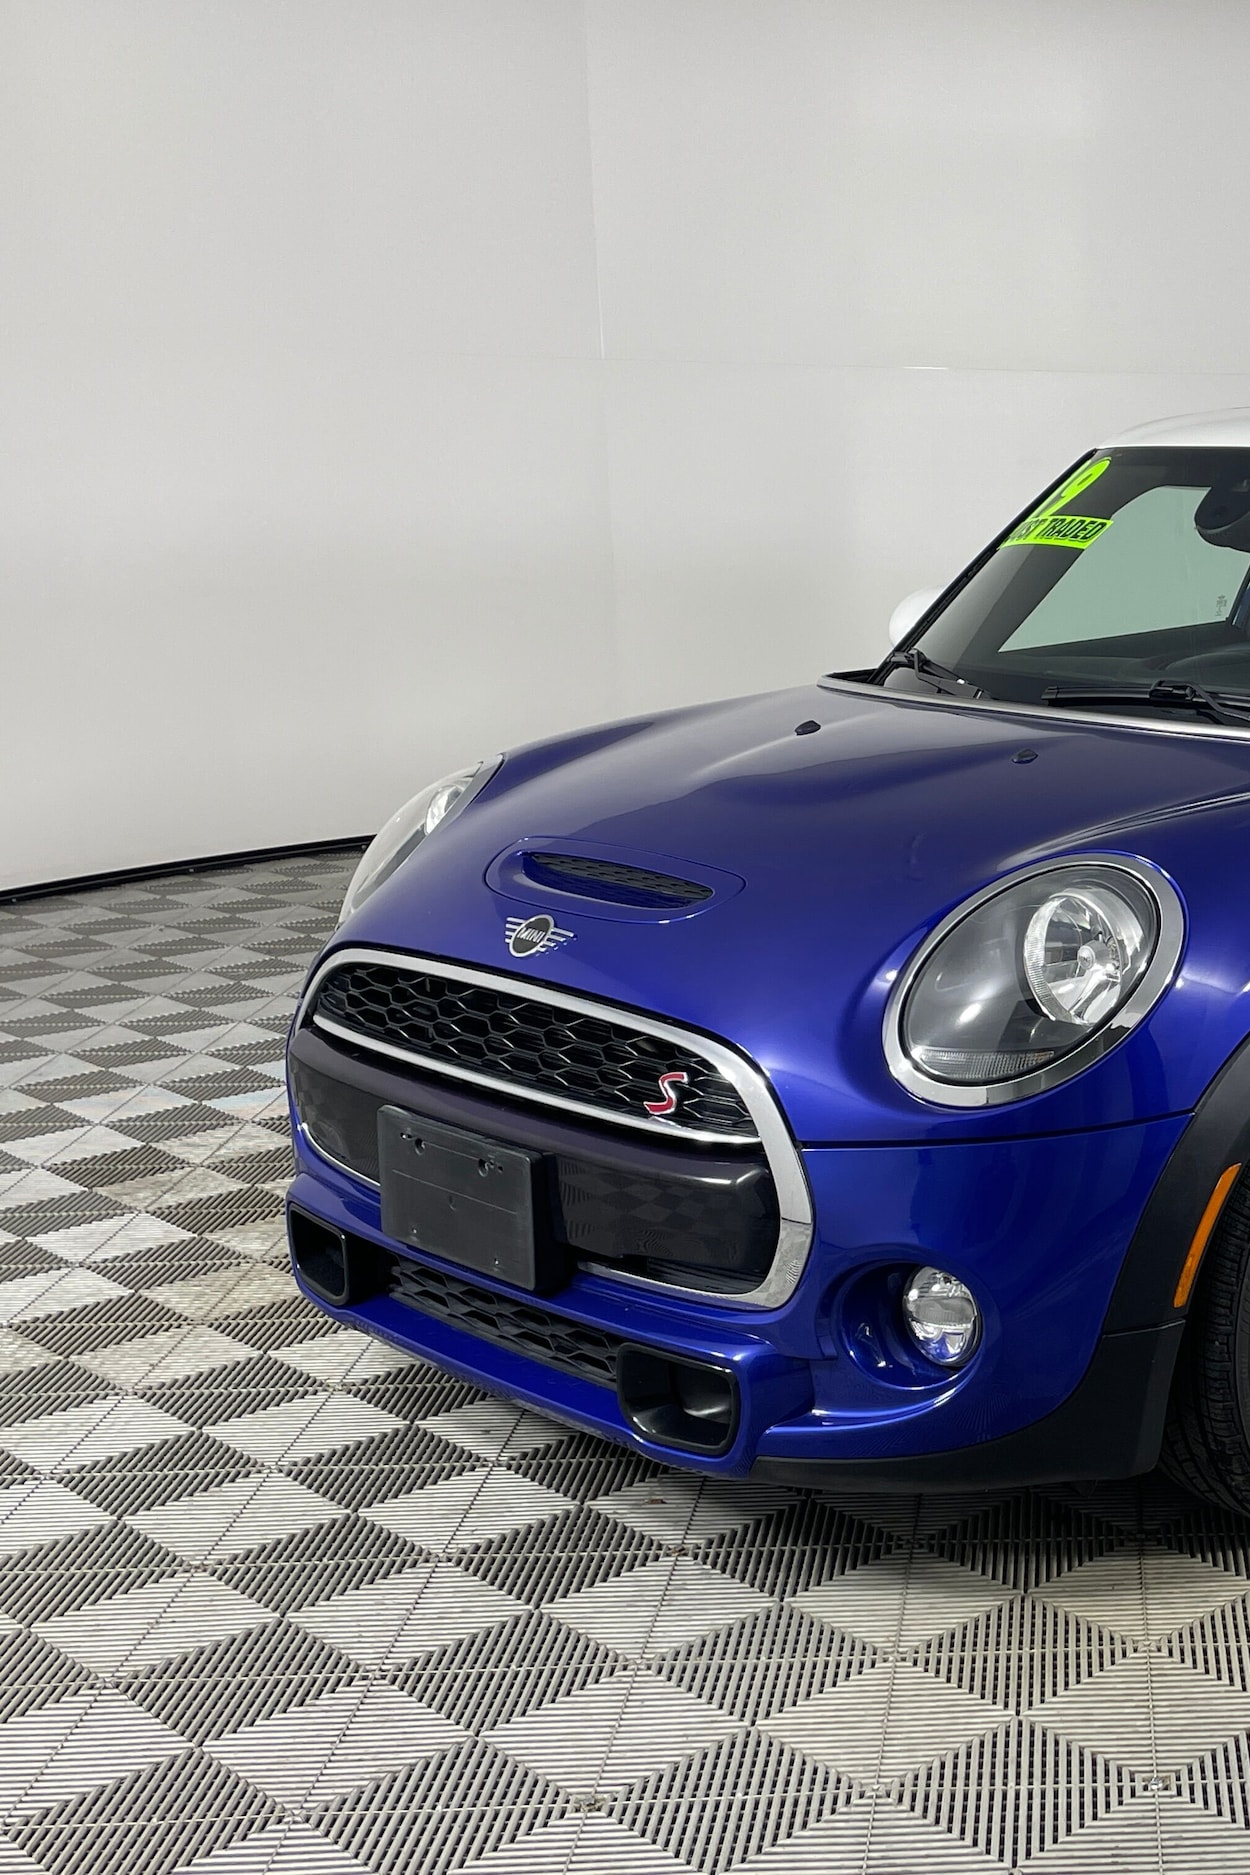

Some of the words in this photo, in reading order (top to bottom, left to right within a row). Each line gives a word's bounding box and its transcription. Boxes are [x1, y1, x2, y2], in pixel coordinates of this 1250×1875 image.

[1006, 518, 1048, 541] UST
[1034, 518, 1107, 541] TRADED
[516, 926, 546, 943] MINI
[643, 1071, 688, 1115] S
